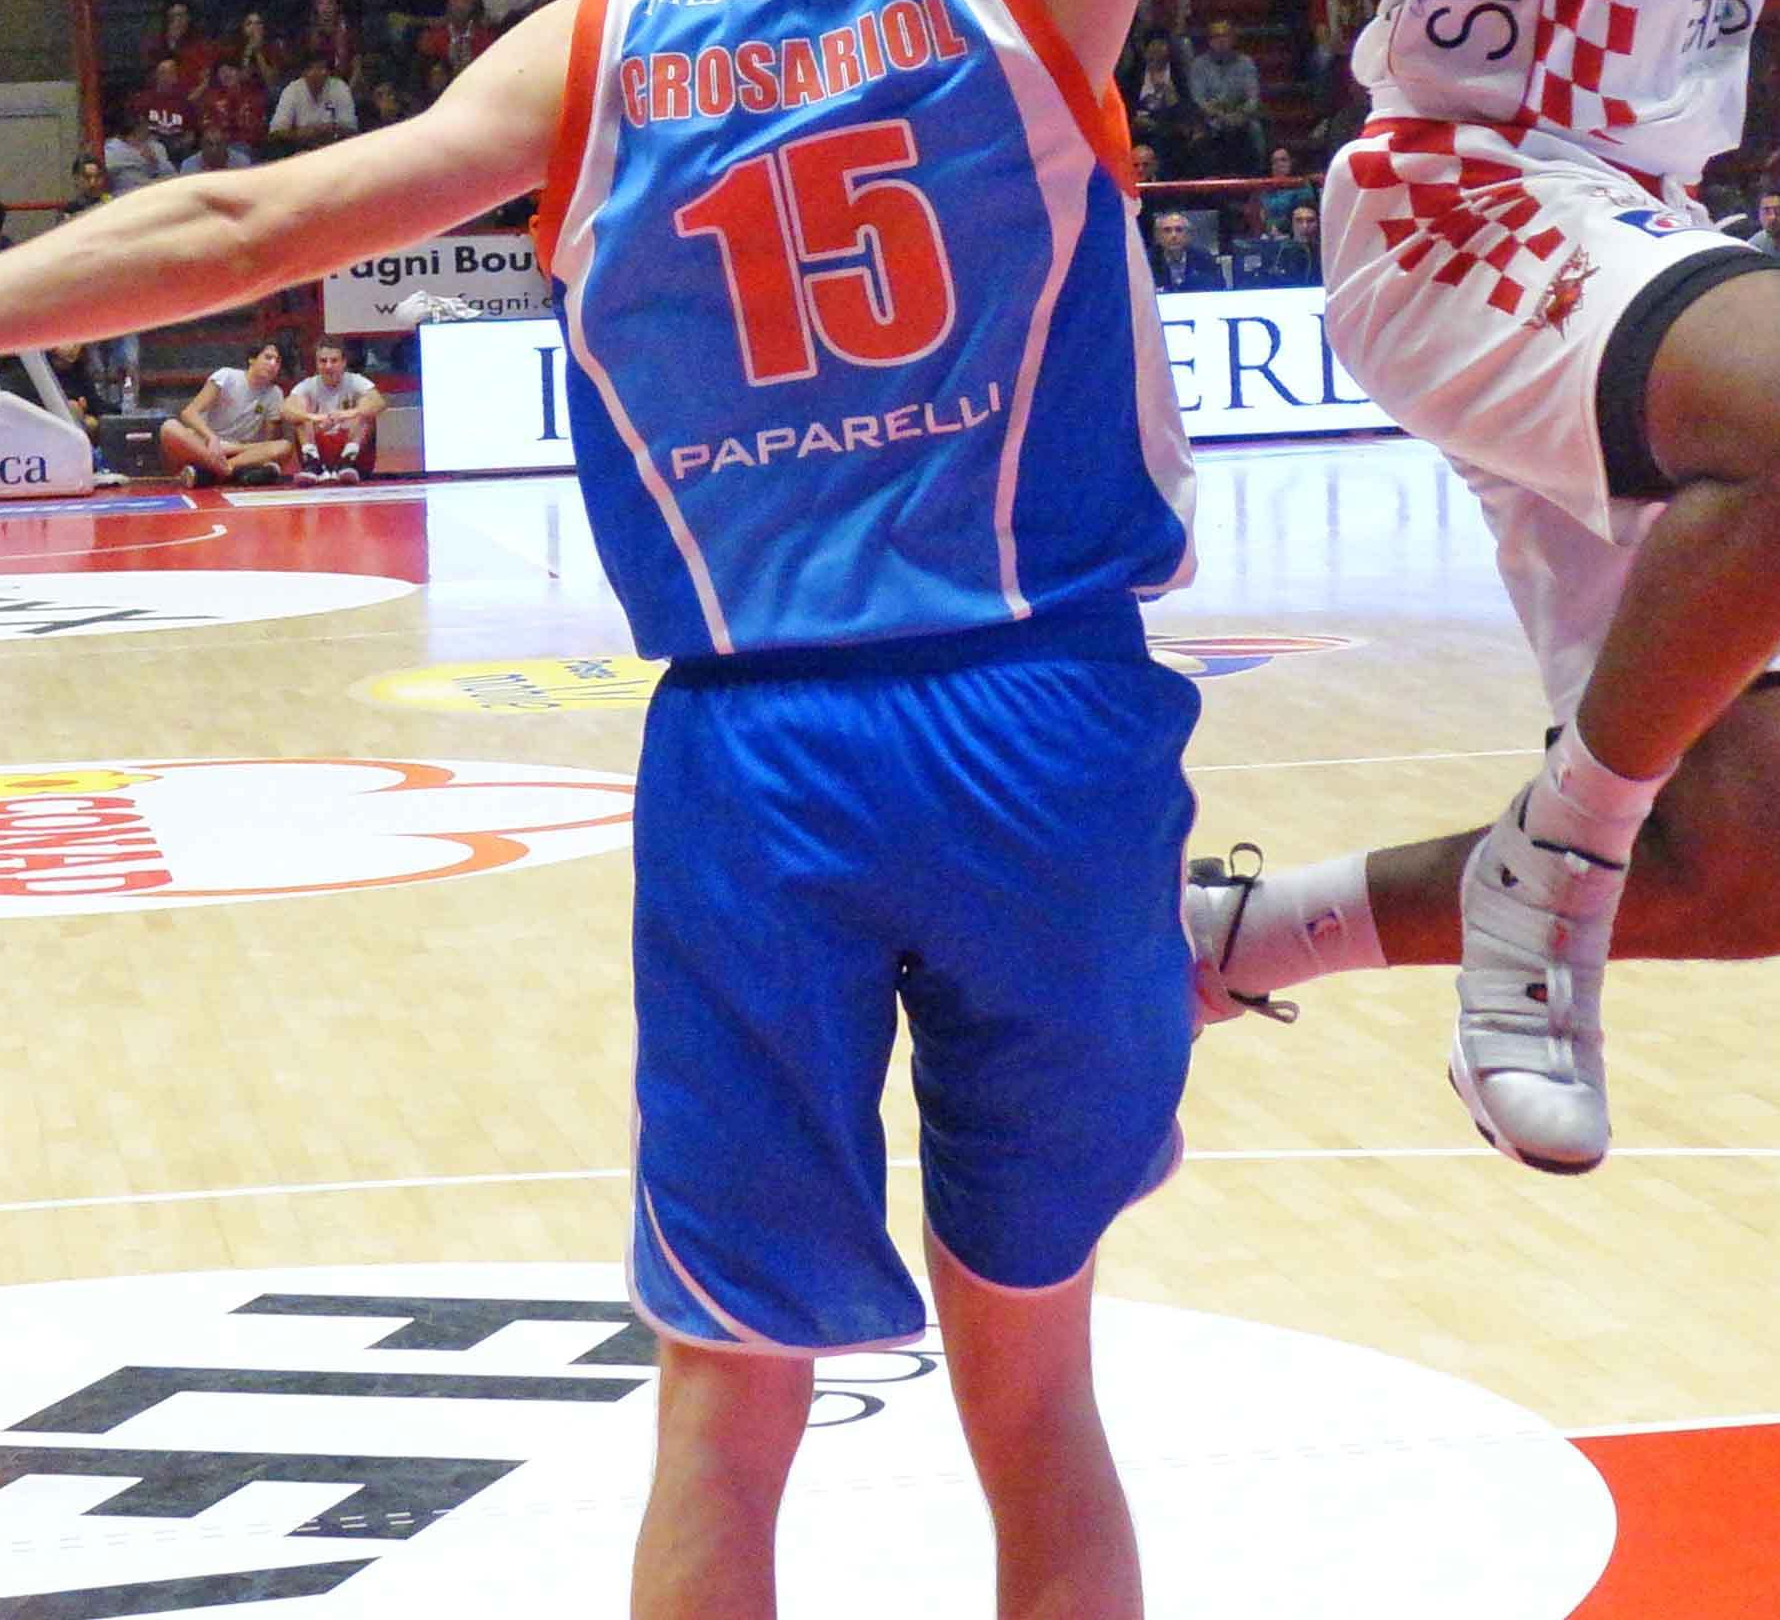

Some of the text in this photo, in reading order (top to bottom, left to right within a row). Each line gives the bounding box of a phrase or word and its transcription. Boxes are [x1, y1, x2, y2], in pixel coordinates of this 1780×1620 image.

[332, 245, 534, 285] agni Bou
[673, 117, 958, 388] 15
[670, 381, 1004, 481] PAPARELLI
